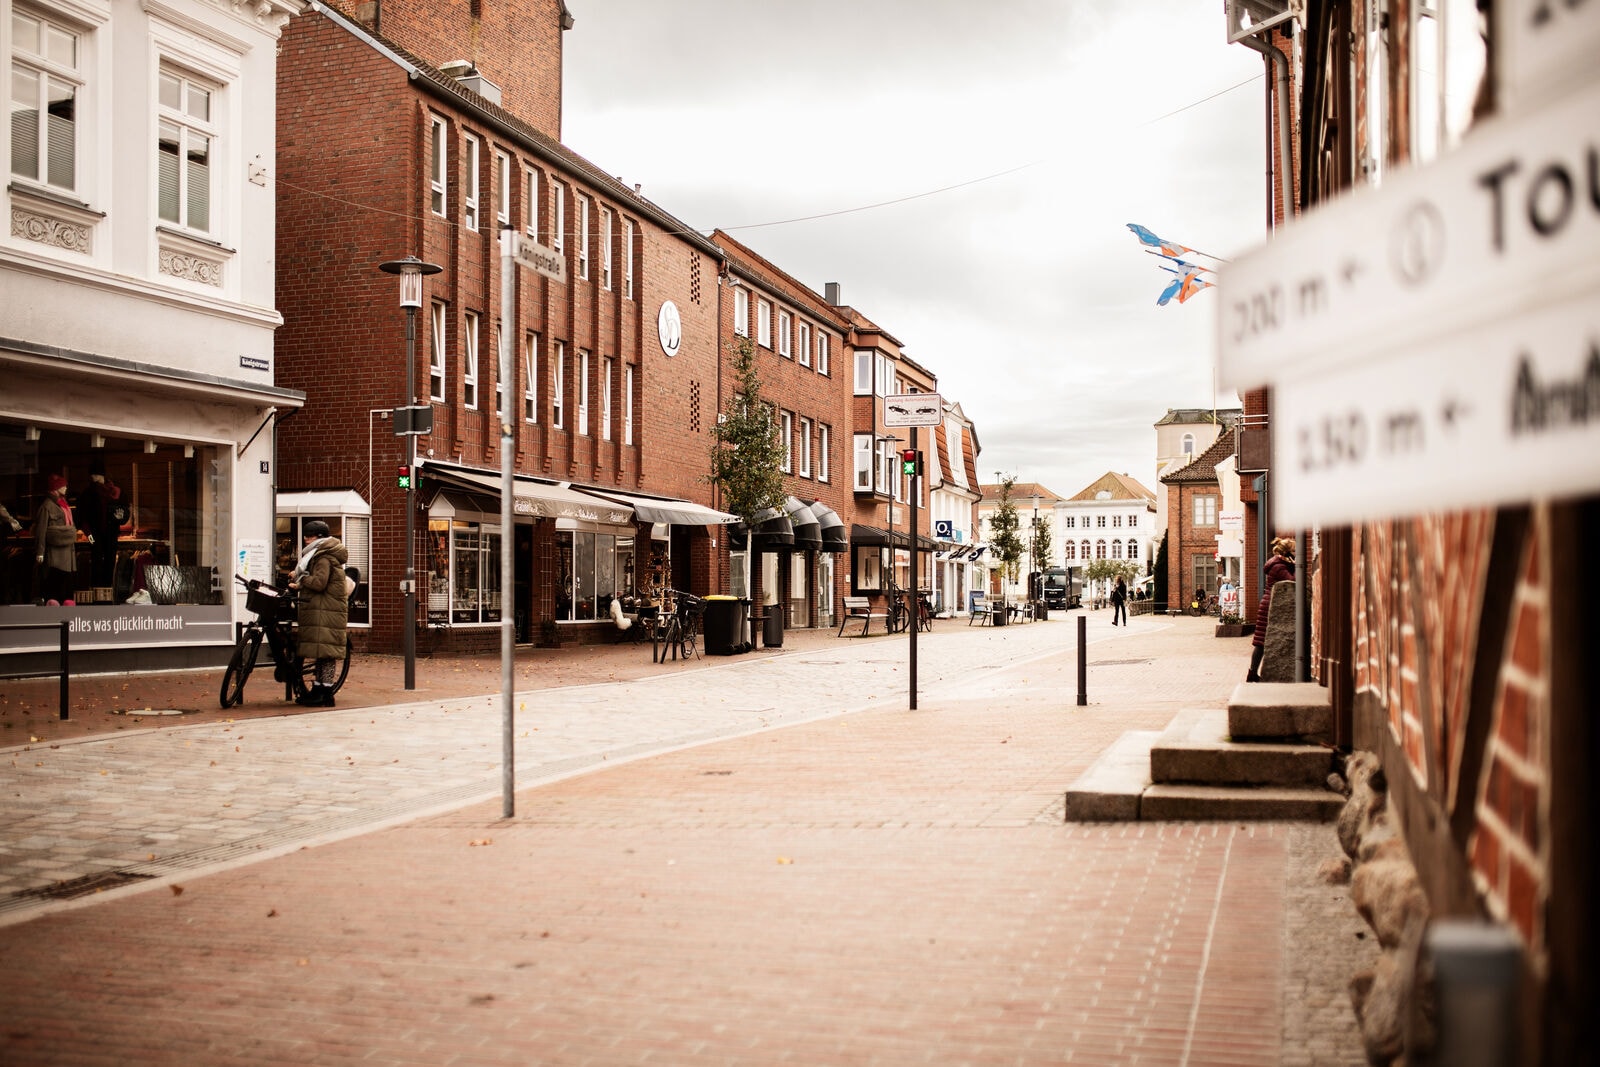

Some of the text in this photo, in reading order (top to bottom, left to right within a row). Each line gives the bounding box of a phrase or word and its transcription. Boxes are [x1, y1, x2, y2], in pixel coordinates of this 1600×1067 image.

[69, 615, 183, 634] alles was glücklich macht
